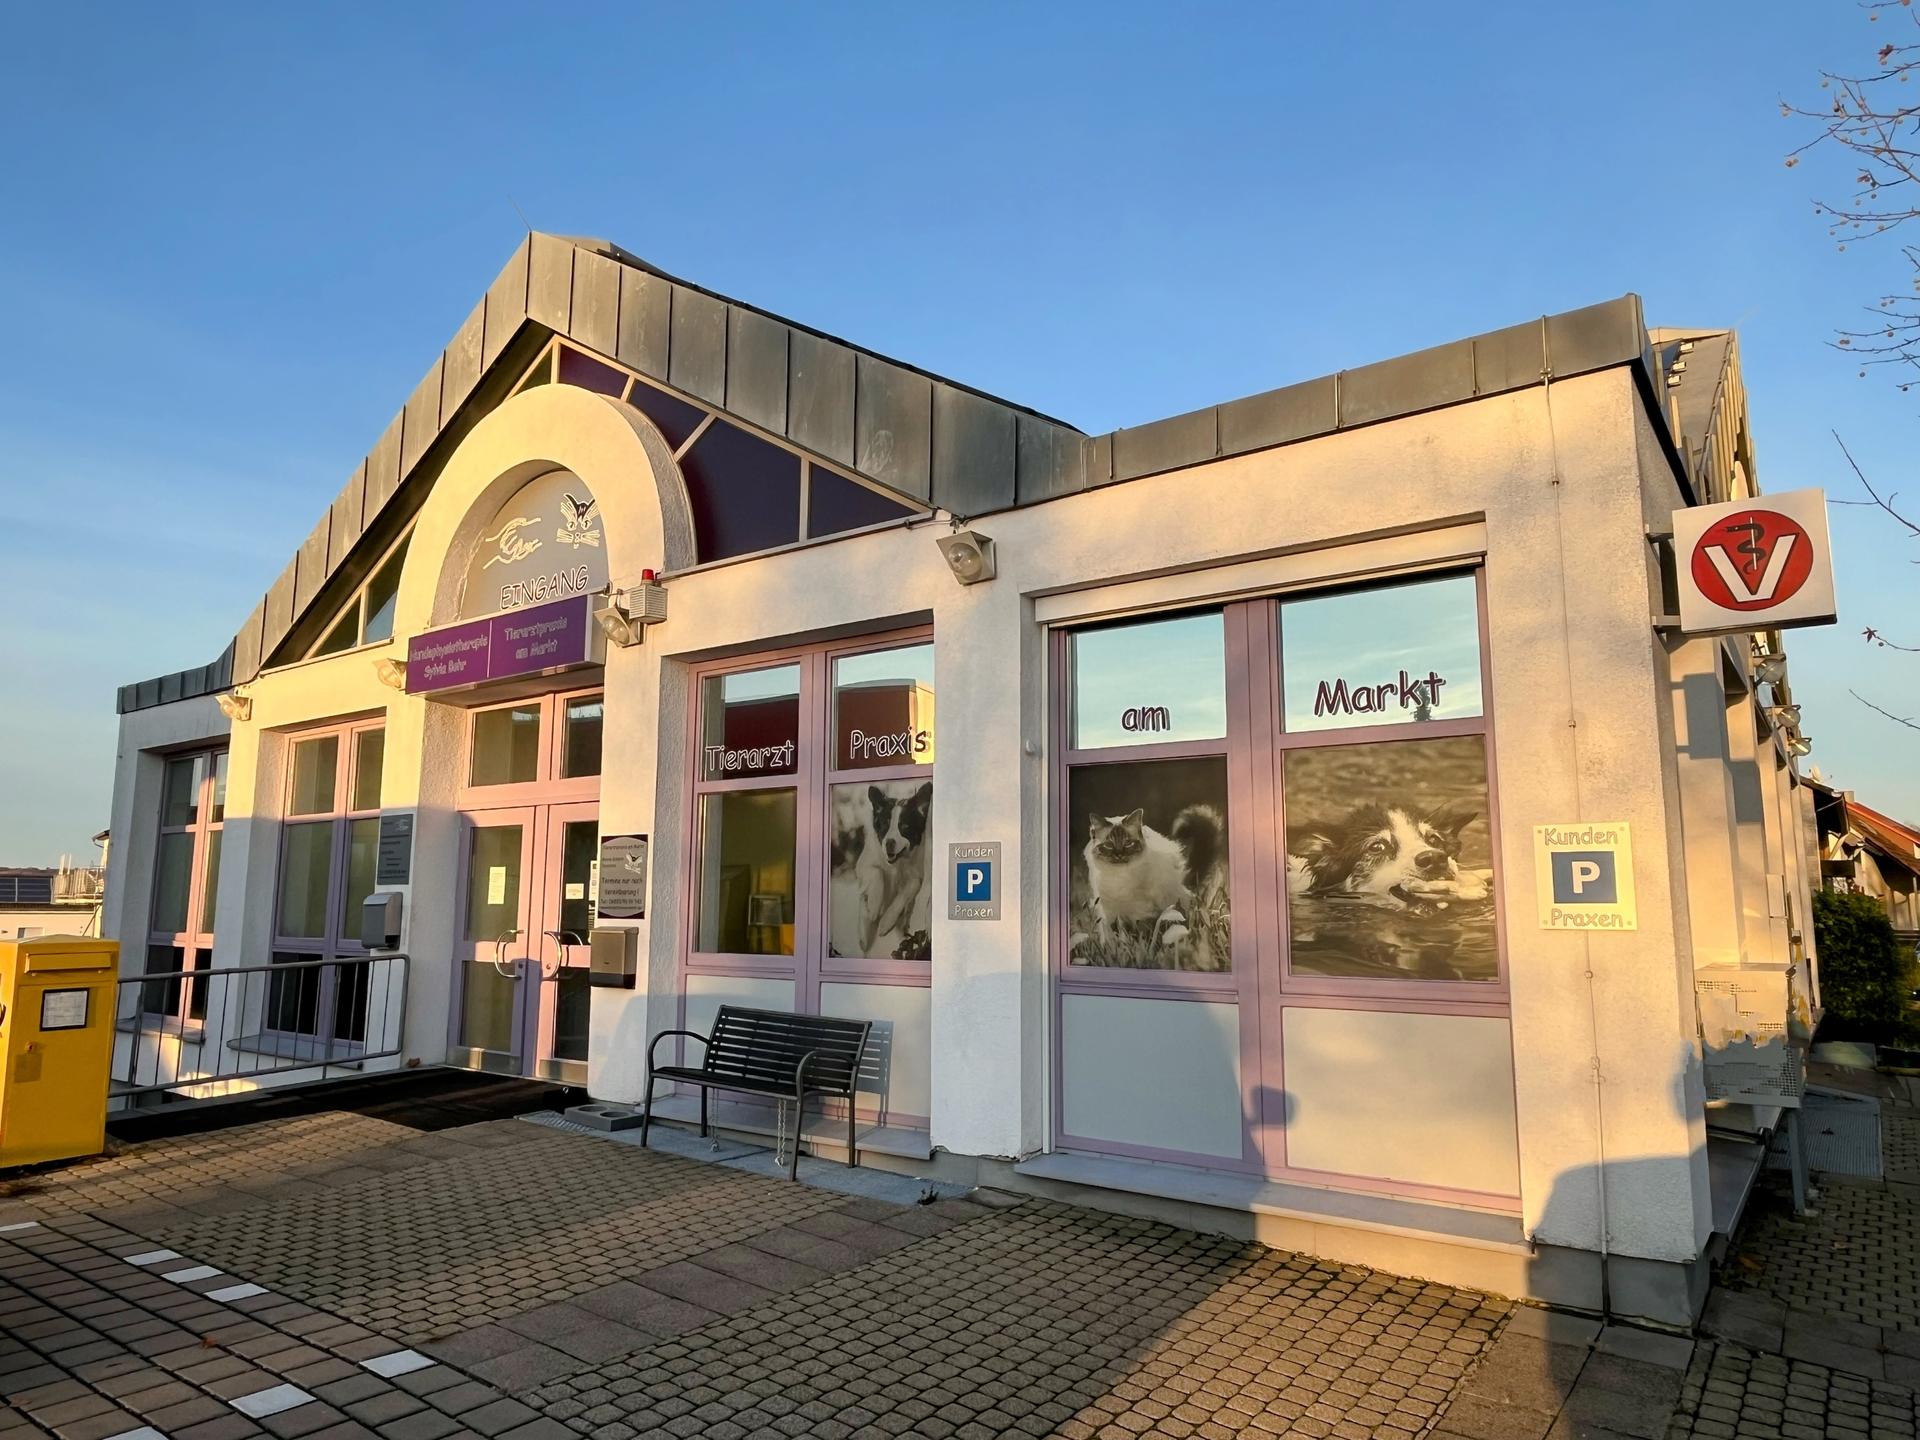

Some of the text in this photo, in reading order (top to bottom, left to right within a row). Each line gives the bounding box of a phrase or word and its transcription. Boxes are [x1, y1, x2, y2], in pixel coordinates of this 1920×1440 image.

[1702, 532, 1800, 603] V
[500, 565, 589, 610] EINGANG
[1121, 670, 1446, 732] am Markt
[705, 726, 928, 771] Tierarzt Praxis
[1544, 826, 1619, 846] Kunden
[954, 846, 994, 858] Kunden
[967, 868, 984, 894] P
[1571, 860, 1601, 894] P
[954, 904, 994, 917] Praxen
[1550, 908, 1624, 928] Praxen
